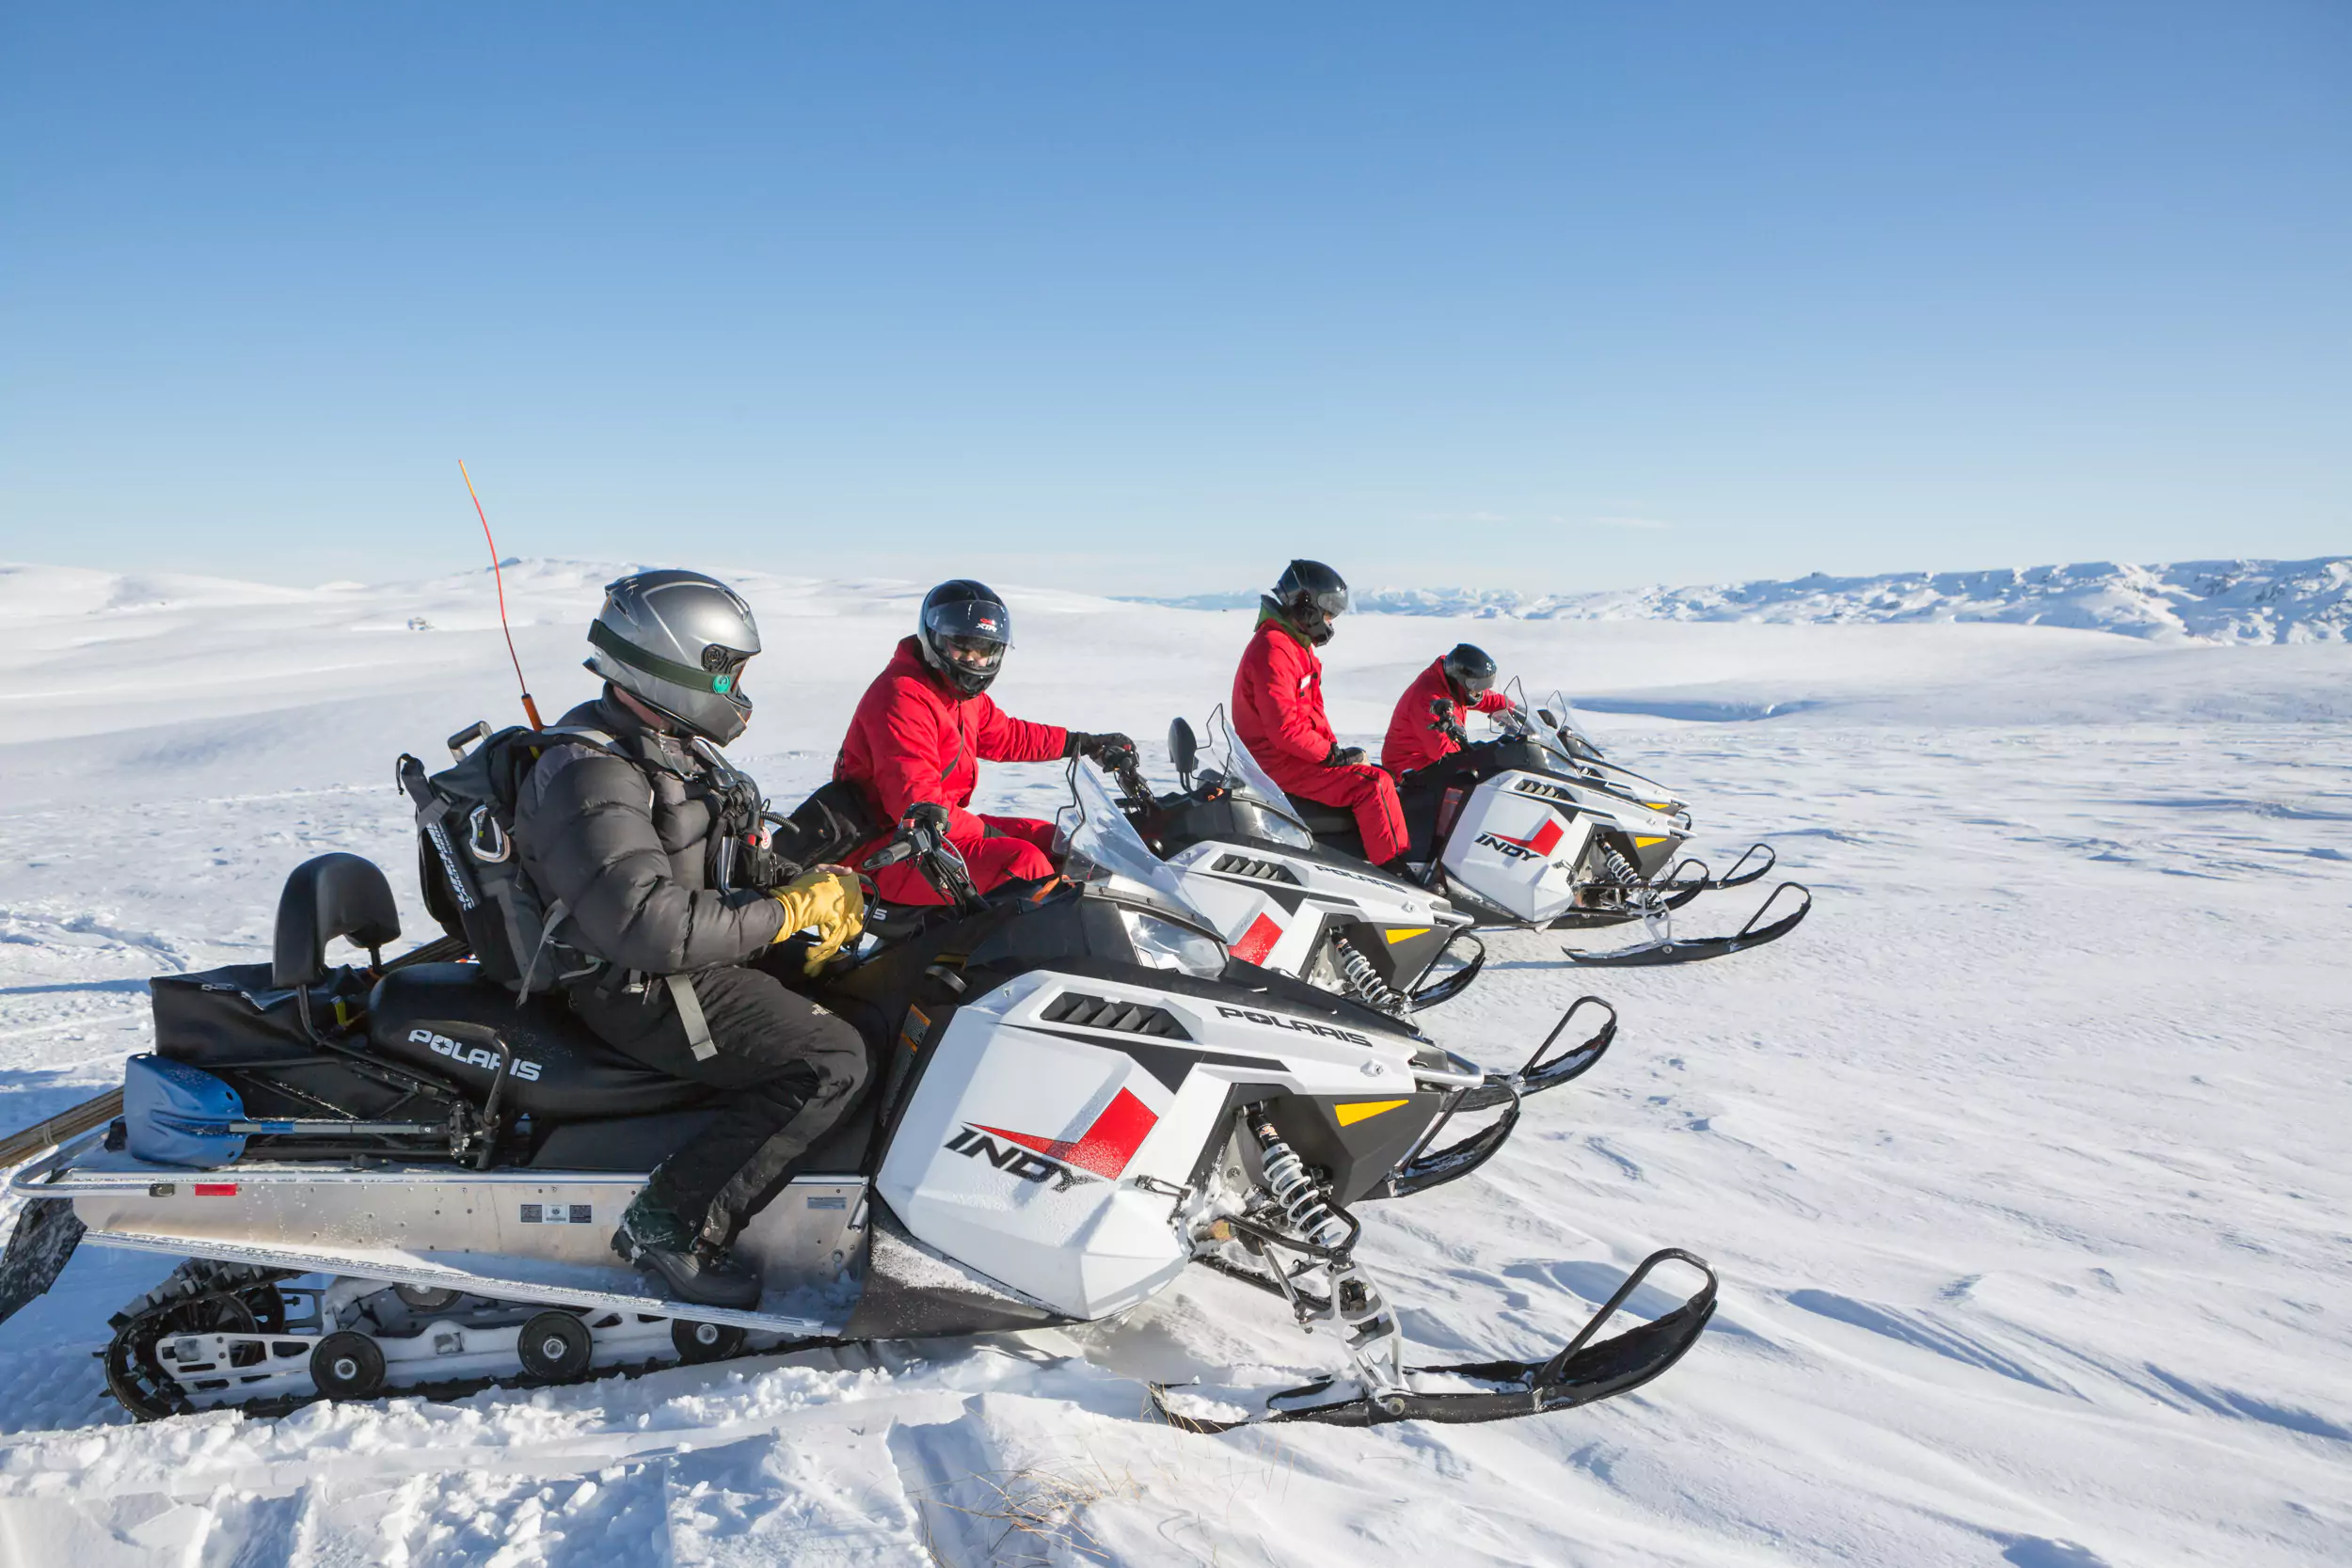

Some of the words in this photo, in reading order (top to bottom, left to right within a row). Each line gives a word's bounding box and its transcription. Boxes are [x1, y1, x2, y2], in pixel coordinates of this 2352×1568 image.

[1474, 833, 1541, 861] INDY
[1216, 1006, 1373, 1048] POLARIS
[944, 1125, 1104, 1193] INDY
